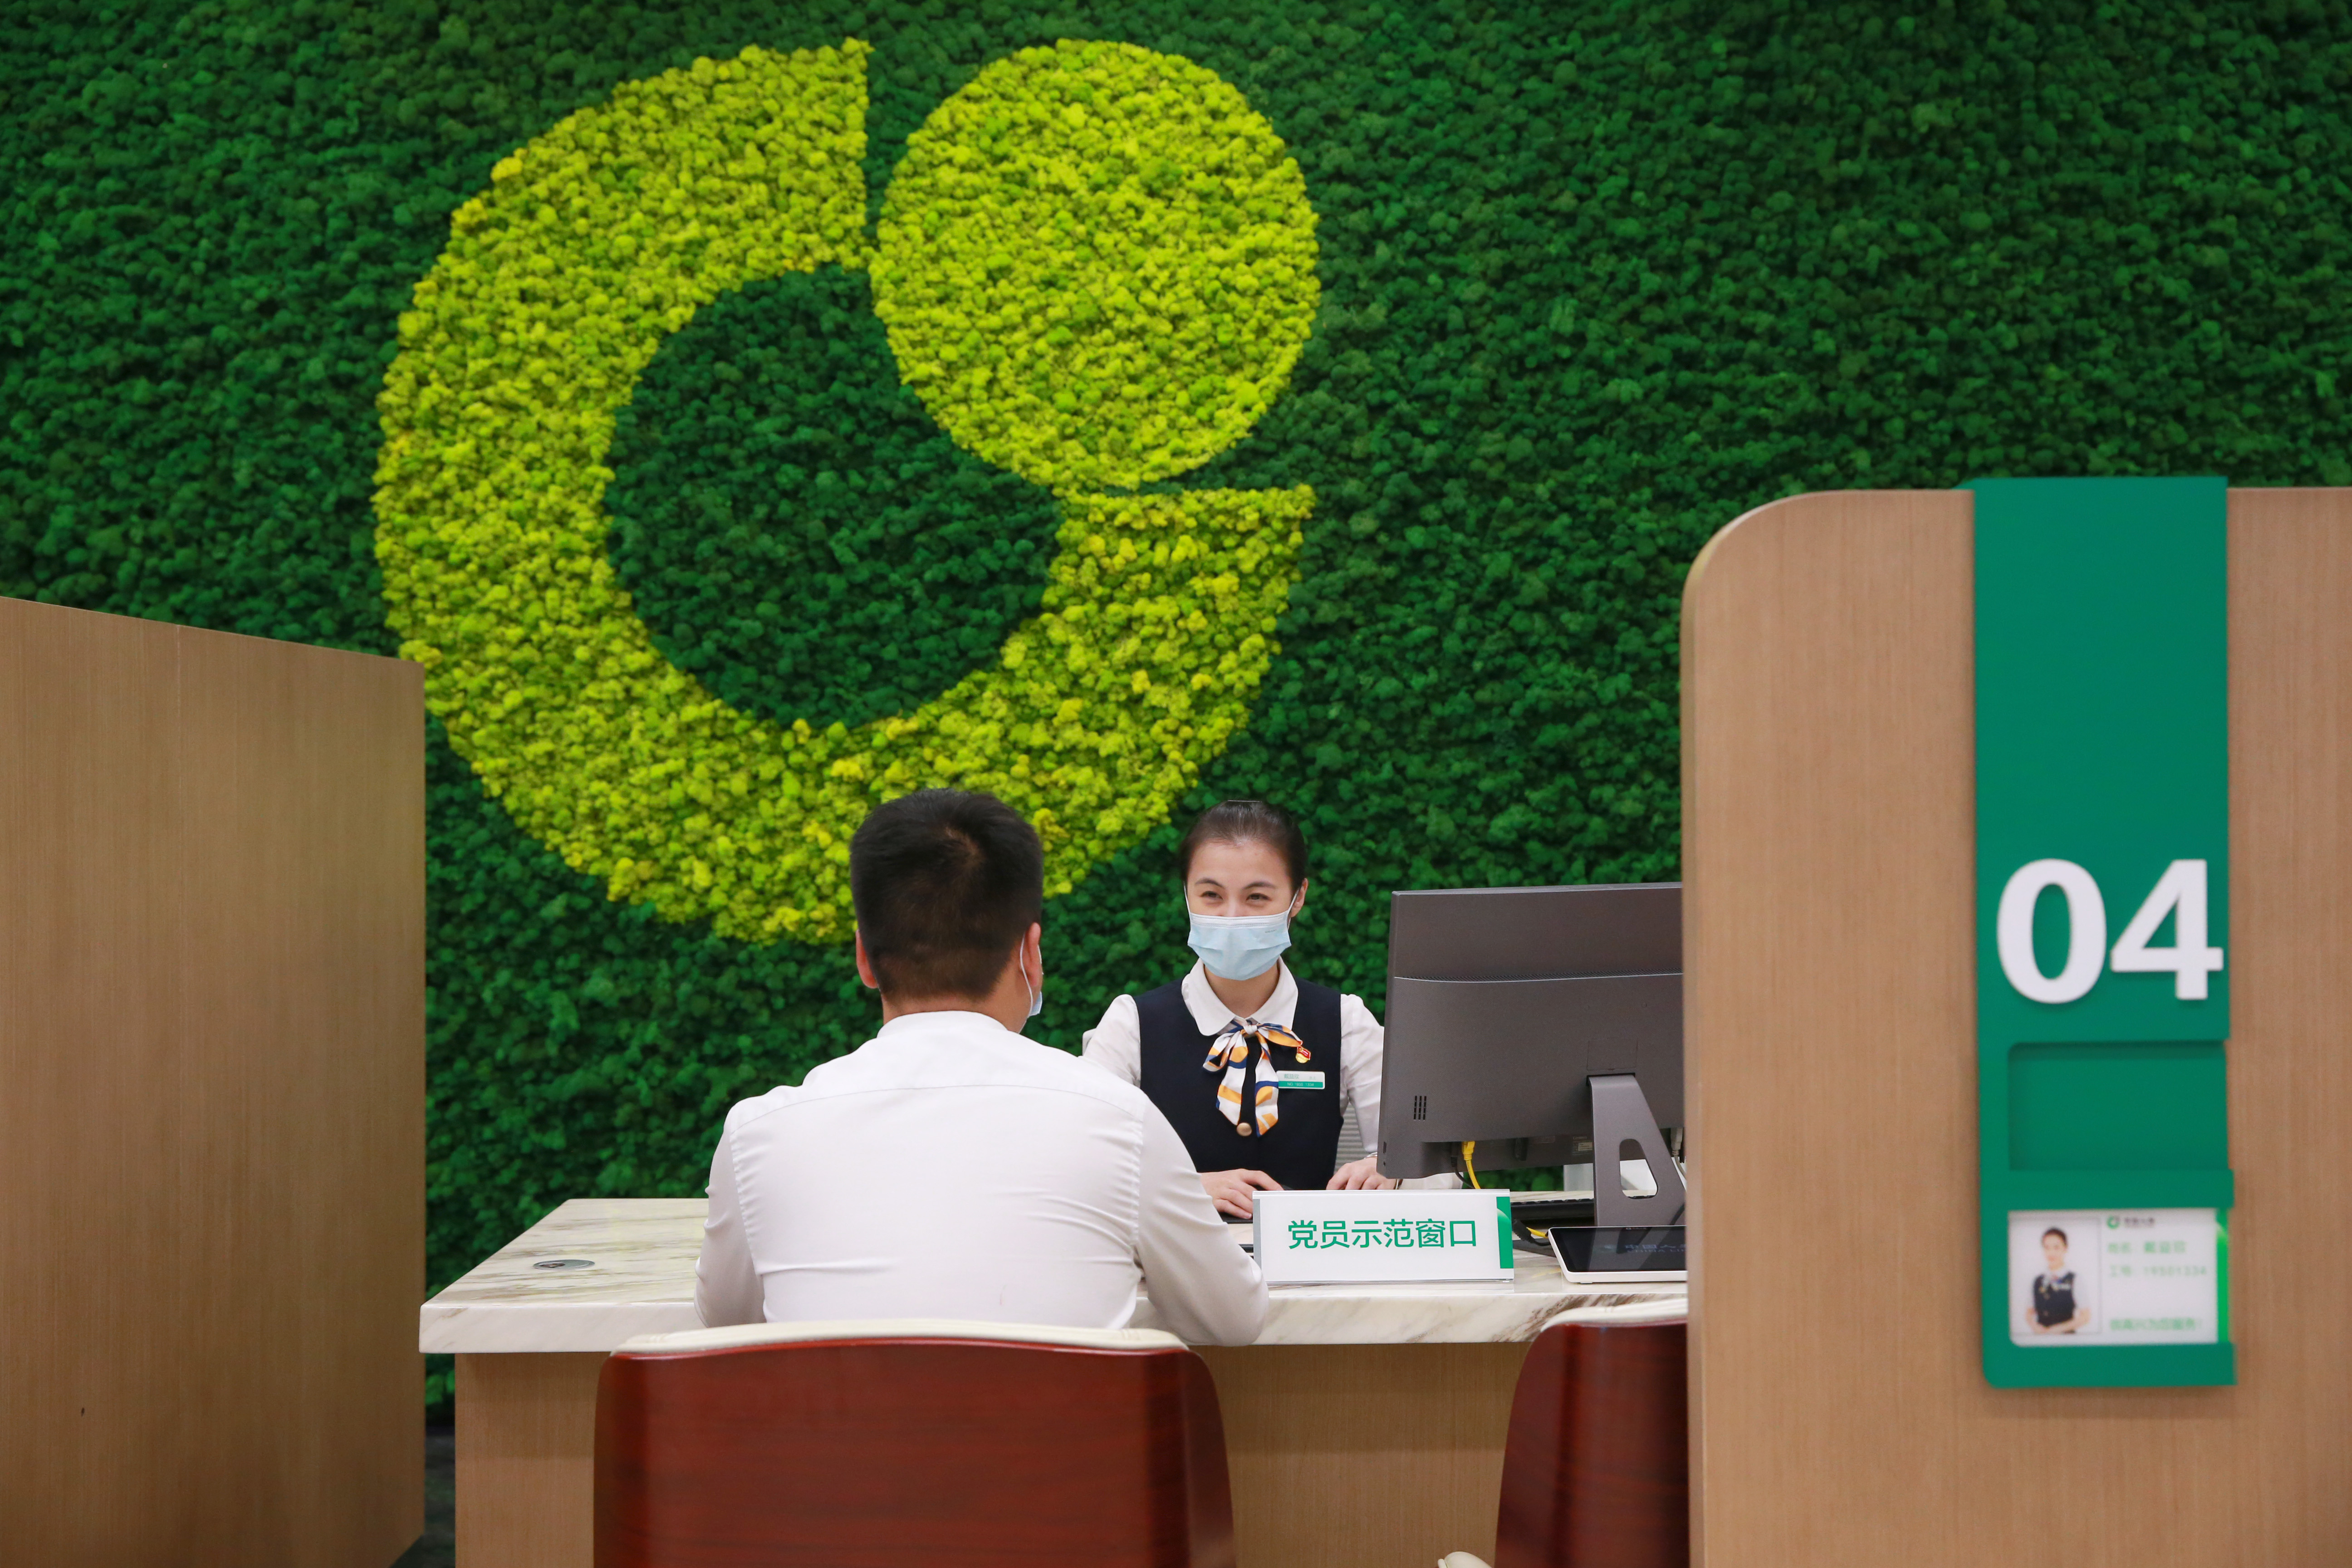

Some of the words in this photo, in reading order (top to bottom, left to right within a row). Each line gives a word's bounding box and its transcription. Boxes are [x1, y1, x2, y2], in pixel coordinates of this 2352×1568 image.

[1997, 858, 2224, 1004] 04
[1288, 1219, 1477, 1249] 党员示范窗口
